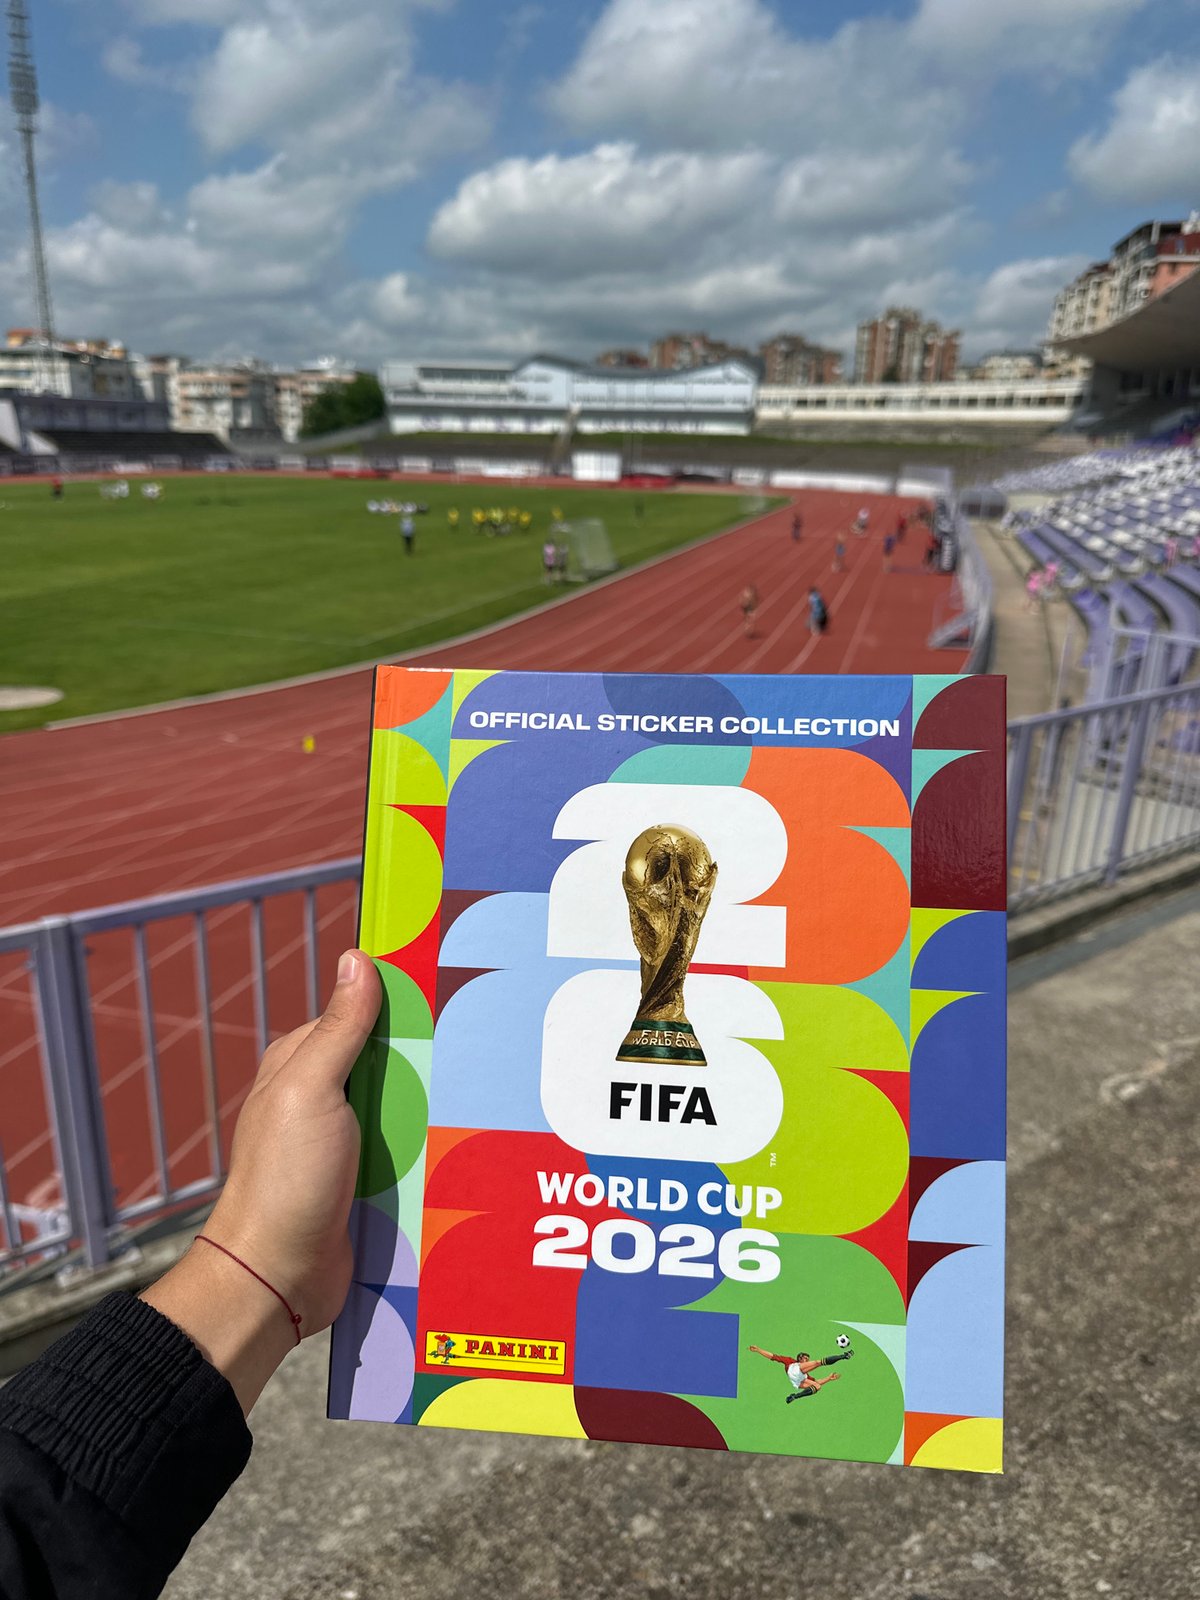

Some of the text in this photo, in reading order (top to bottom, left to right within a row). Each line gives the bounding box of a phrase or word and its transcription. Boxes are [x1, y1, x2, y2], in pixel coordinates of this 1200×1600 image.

[469, 711, 900, 737] OFFICIAL STICKER COLLECTION
[632, 1038, 696, 1048] WORLD CUP
[641, 1029, 687, 1040] FIFA
[609, 1081, 718, 1126] FIFA
[536, 1170, 783, 1219] WORLD CUP
[532, 1214, 782, 1283] 2026
[464, 1339, 559, 1361] PANINI
